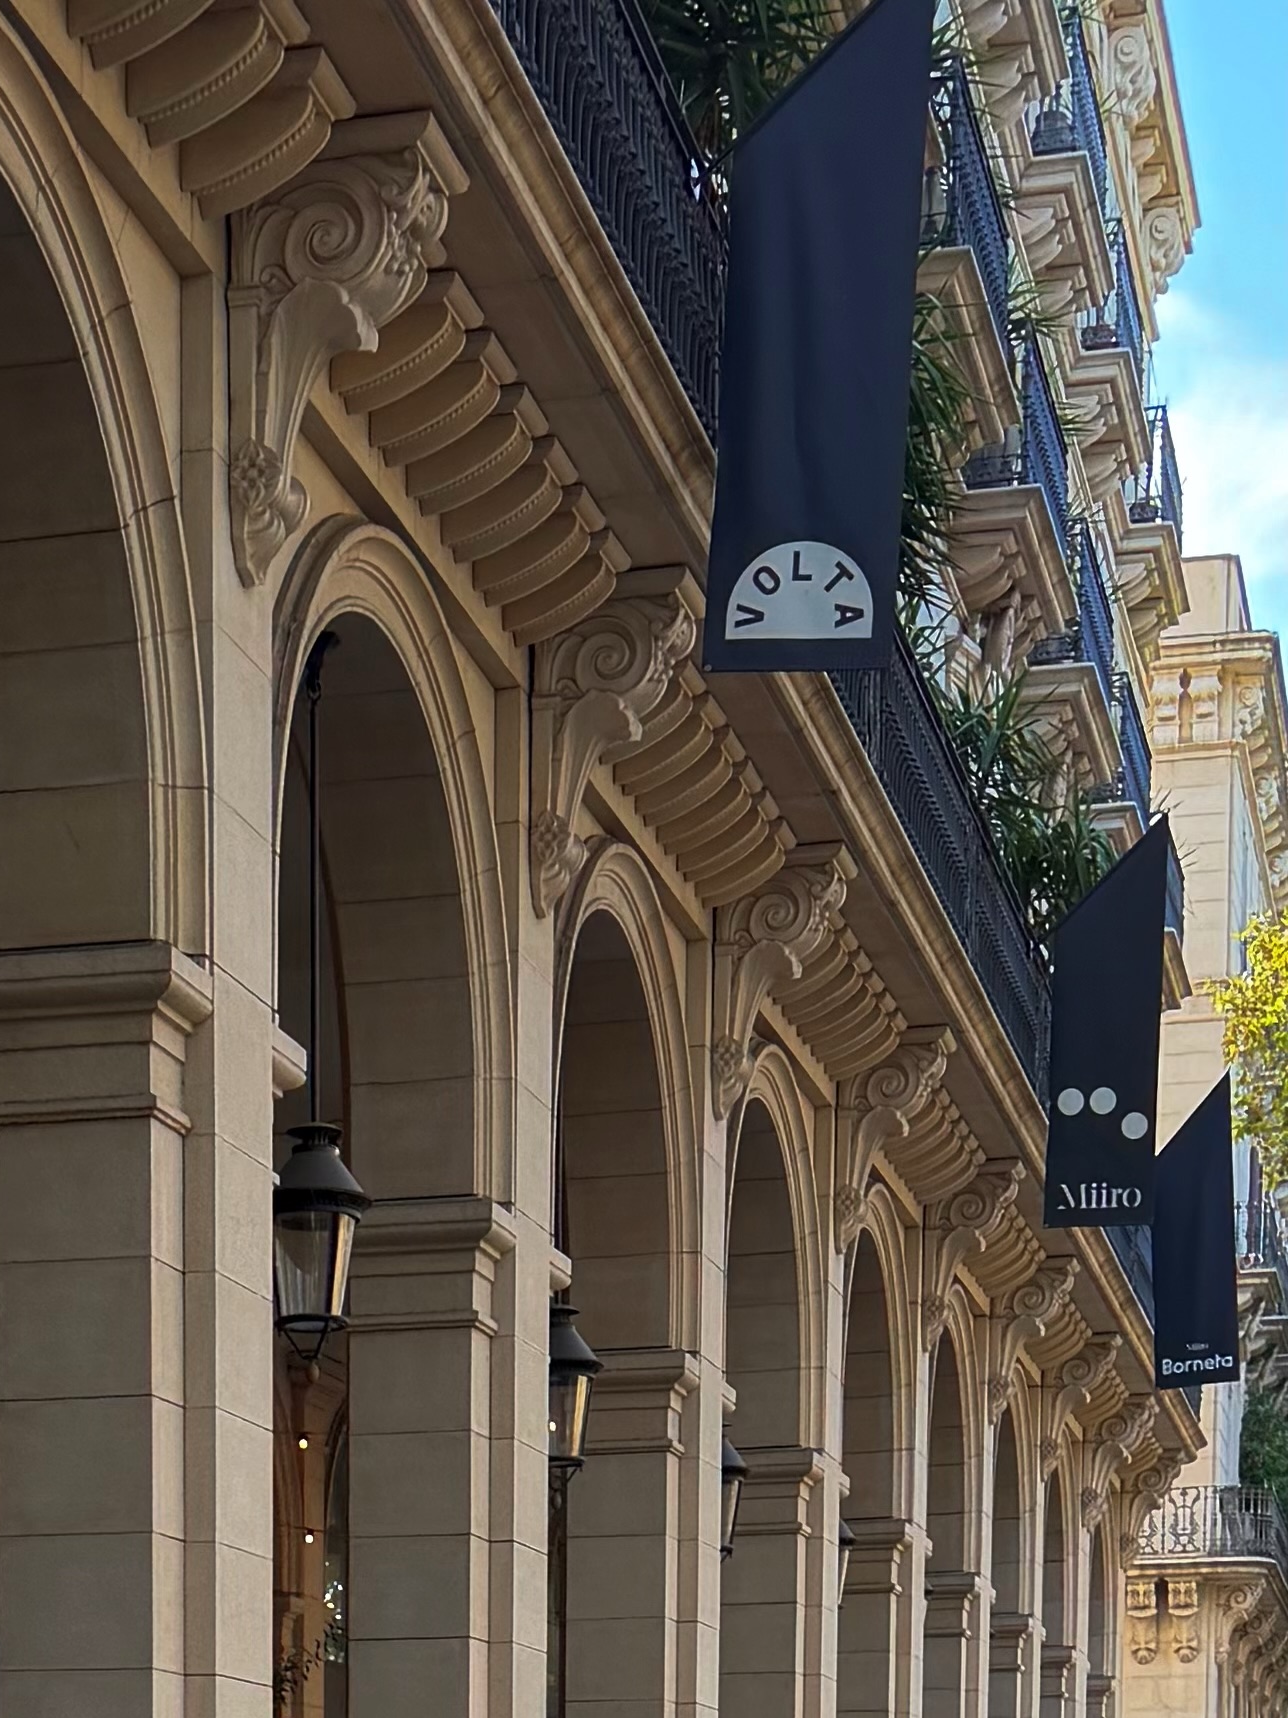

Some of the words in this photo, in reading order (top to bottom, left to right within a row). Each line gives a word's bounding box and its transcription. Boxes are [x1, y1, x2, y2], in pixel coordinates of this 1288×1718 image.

[734, 551, 864, 629] VOLTA
[1057, 1182, 1142, 1209] Miiro
[1162, 1354, 1233, 1376] Borneta
